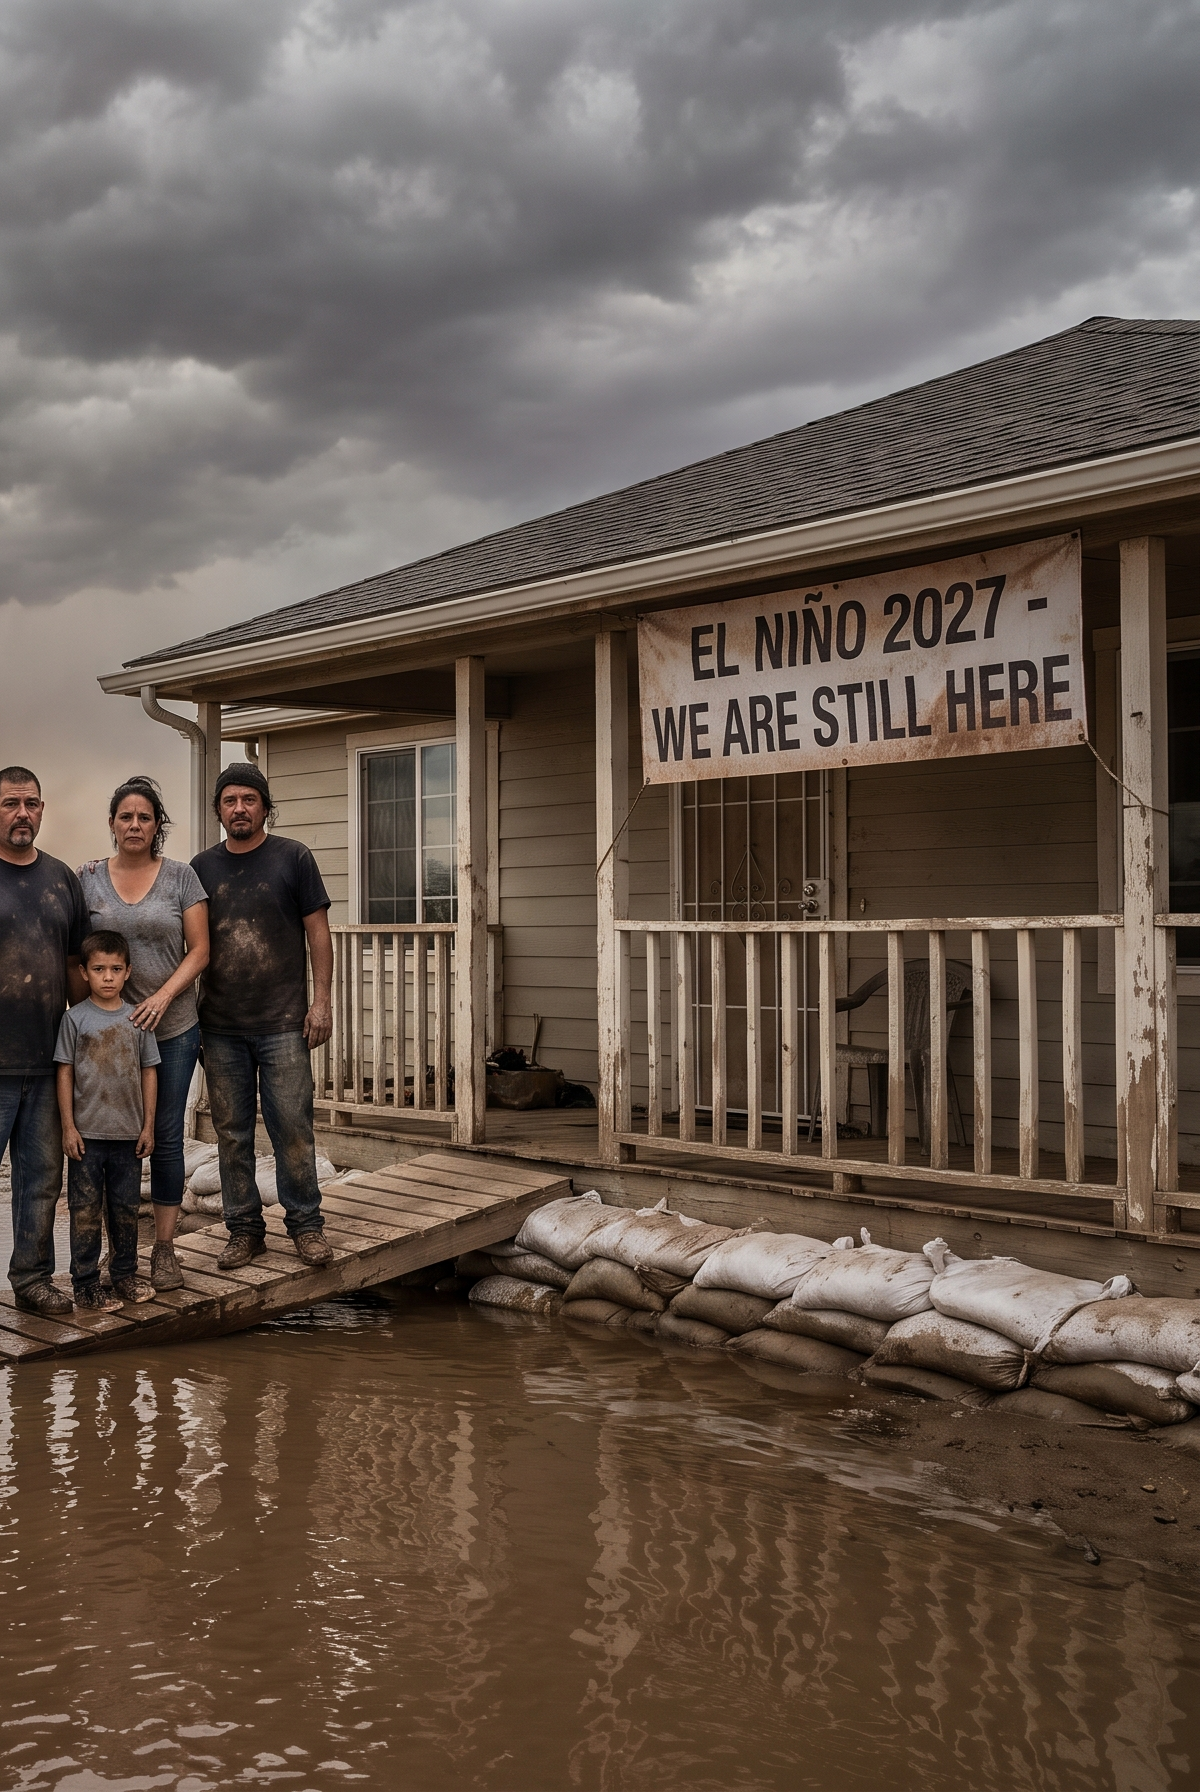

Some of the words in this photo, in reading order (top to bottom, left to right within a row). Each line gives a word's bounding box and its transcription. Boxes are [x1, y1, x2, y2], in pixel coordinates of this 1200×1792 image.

[691, 622, 739, 682] EL
[754, 591, 866, 672] NIÑO
[883, 574, 1007, 654] 2027
[651, 702, 711, 763] WE
[722, 690, 801, 757] ARE
[812, 675, 932, 748] STILL
[945, 653, 1073, 734] HERE
